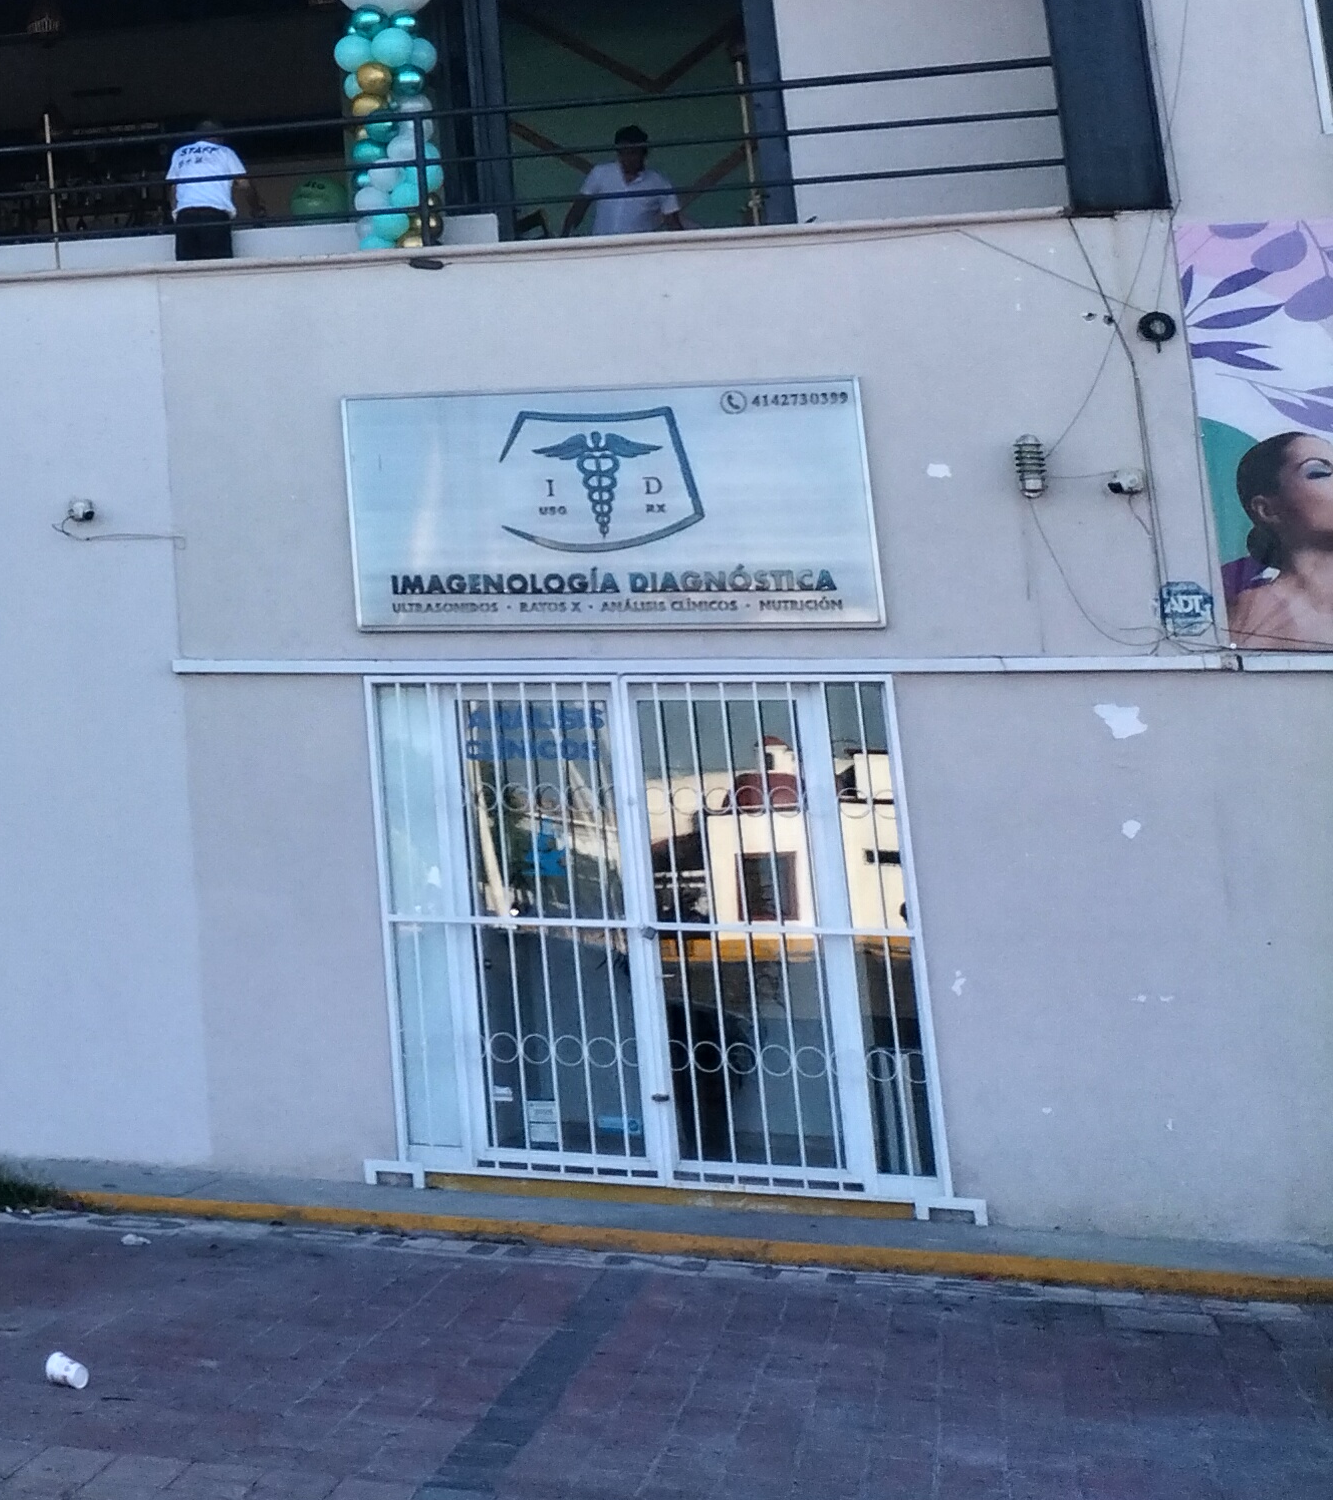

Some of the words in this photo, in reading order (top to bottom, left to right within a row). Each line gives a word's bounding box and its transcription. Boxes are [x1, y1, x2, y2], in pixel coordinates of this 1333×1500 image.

[180, 146, 220, 157] STAFF
[751, 391, 849, 407] 4142730399
[642, 476, 663, 495] D
[645, 503, 667, 513] RX
[391, 567, 620, 595] IMAGENOLOGÍA
[629, 564, 837, 593] DIAGNÓSTICA
[392, 601, 498, 614] ULTRASONIDOS
[519, 601, 567, 612] RAYOS
[571, 601, 582, 612] X
[601, 598, 666, 612] ANÁLISIS
[671, 597, 738, 611] CLÍNICOS
[760, 596, 843, 611] NUTRICIÓN
[1165, 594, 1203, 613] ADT
